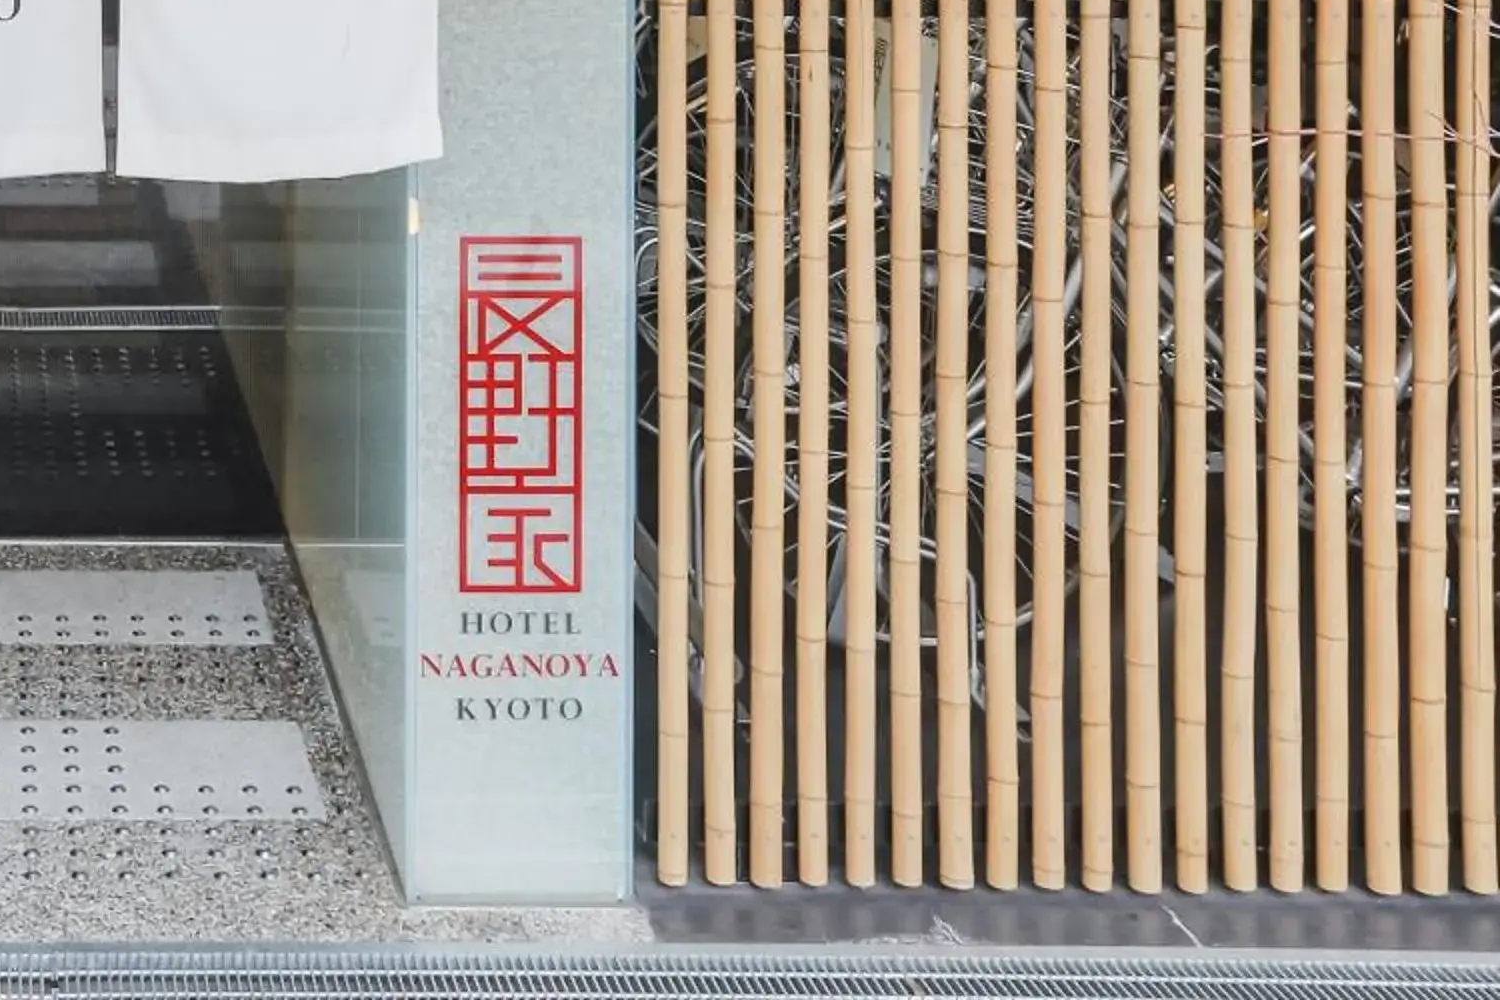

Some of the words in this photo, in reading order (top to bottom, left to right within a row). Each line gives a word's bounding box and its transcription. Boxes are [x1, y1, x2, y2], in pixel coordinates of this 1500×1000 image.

[460, 612, 581, 635] HOTEL
[420, 653, 620, 679] NAGANOYA
[456, 697, 583, 721] KYOTO
